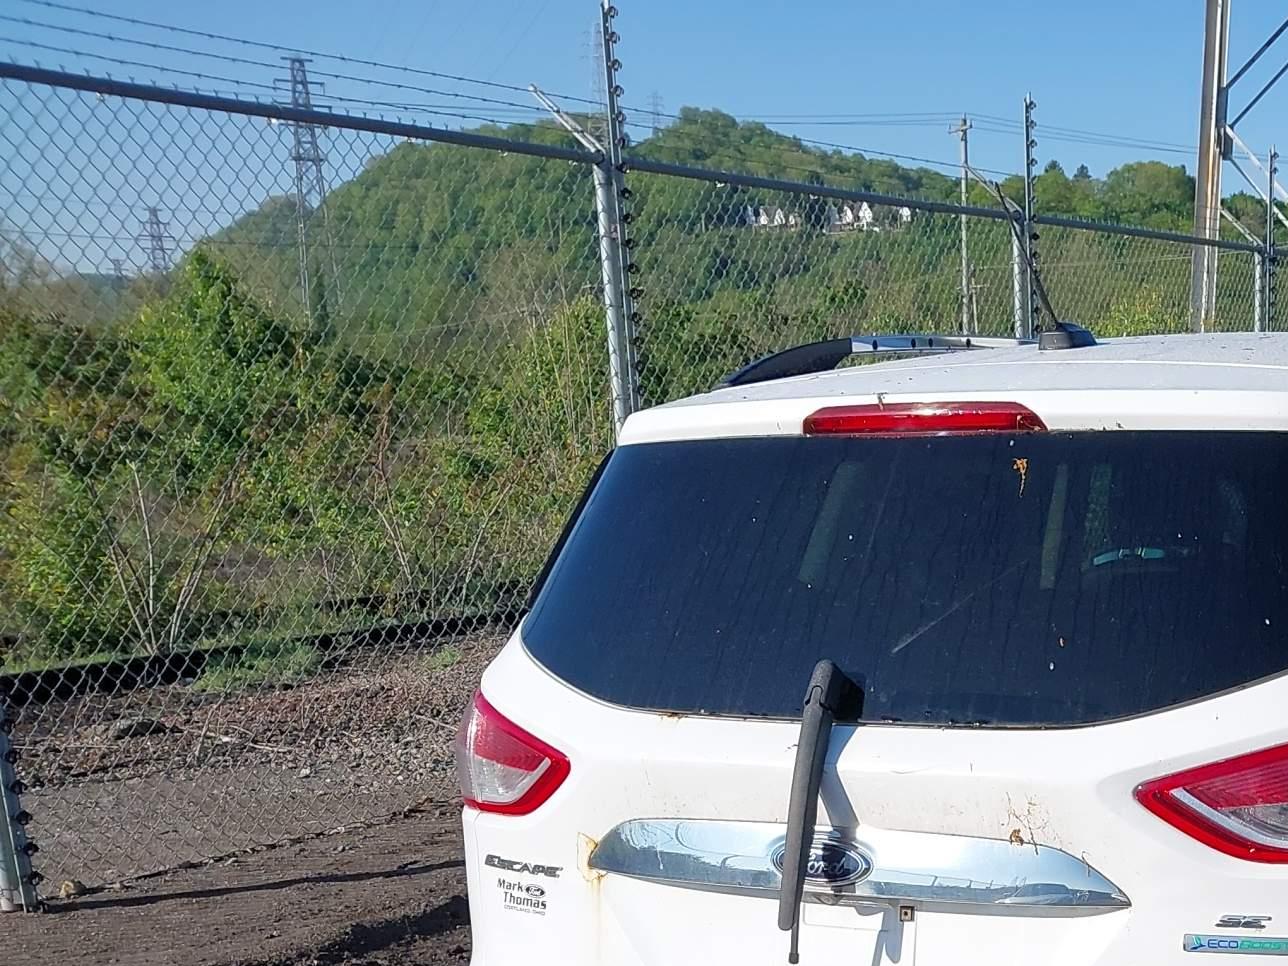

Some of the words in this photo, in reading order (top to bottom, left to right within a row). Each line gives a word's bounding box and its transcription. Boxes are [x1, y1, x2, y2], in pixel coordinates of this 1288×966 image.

[485, 854, 563, 878] ESCAPE
[497, 878, 523, 893] Mark
[504, 892, 547, 910] Thomas
[1215, 915, 1272, 929] SE
